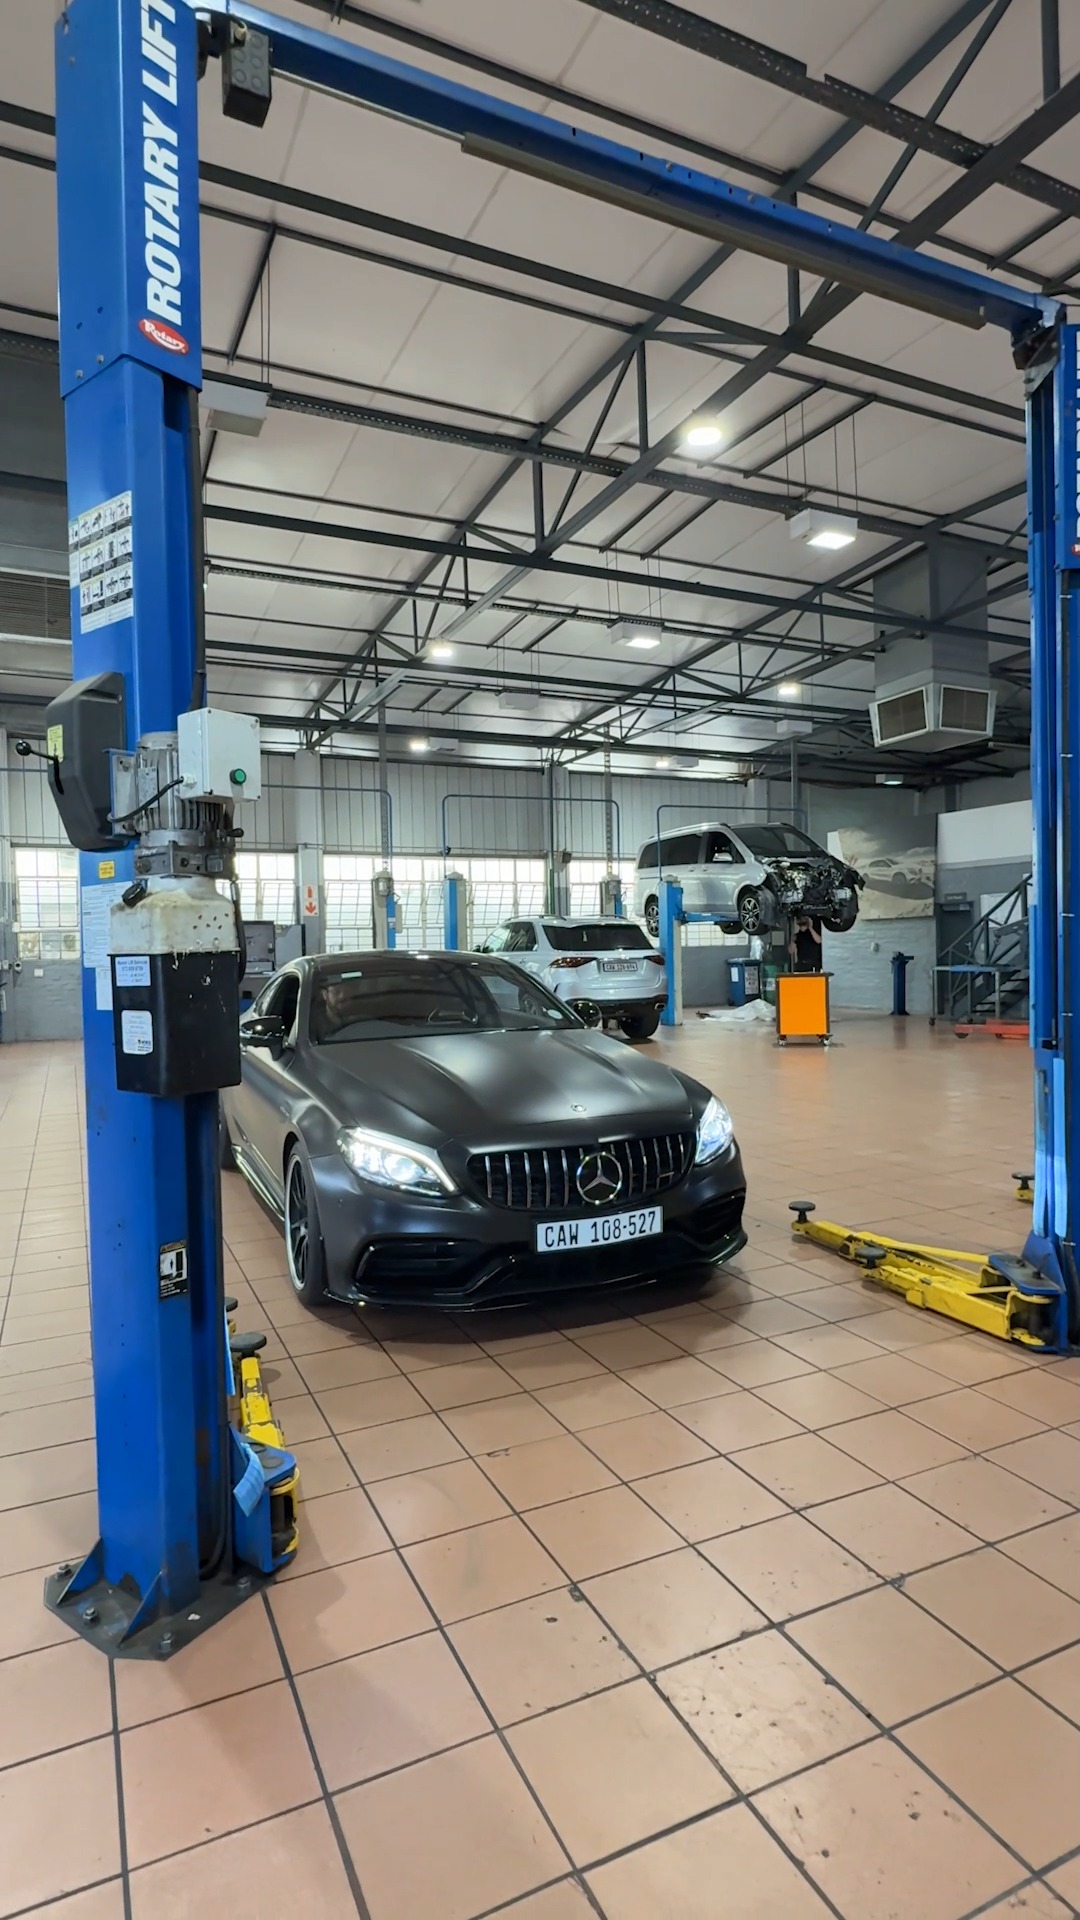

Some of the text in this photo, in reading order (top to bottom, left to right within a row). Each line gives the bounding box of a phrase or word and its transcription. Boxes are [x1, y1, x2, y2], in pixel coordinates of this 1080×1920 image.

[140, 0, 182, 326] ROTARY LIFT
[143, 318, 186, 350] Rotary
[545, 1210, 656, 1247] CAW 108-527
